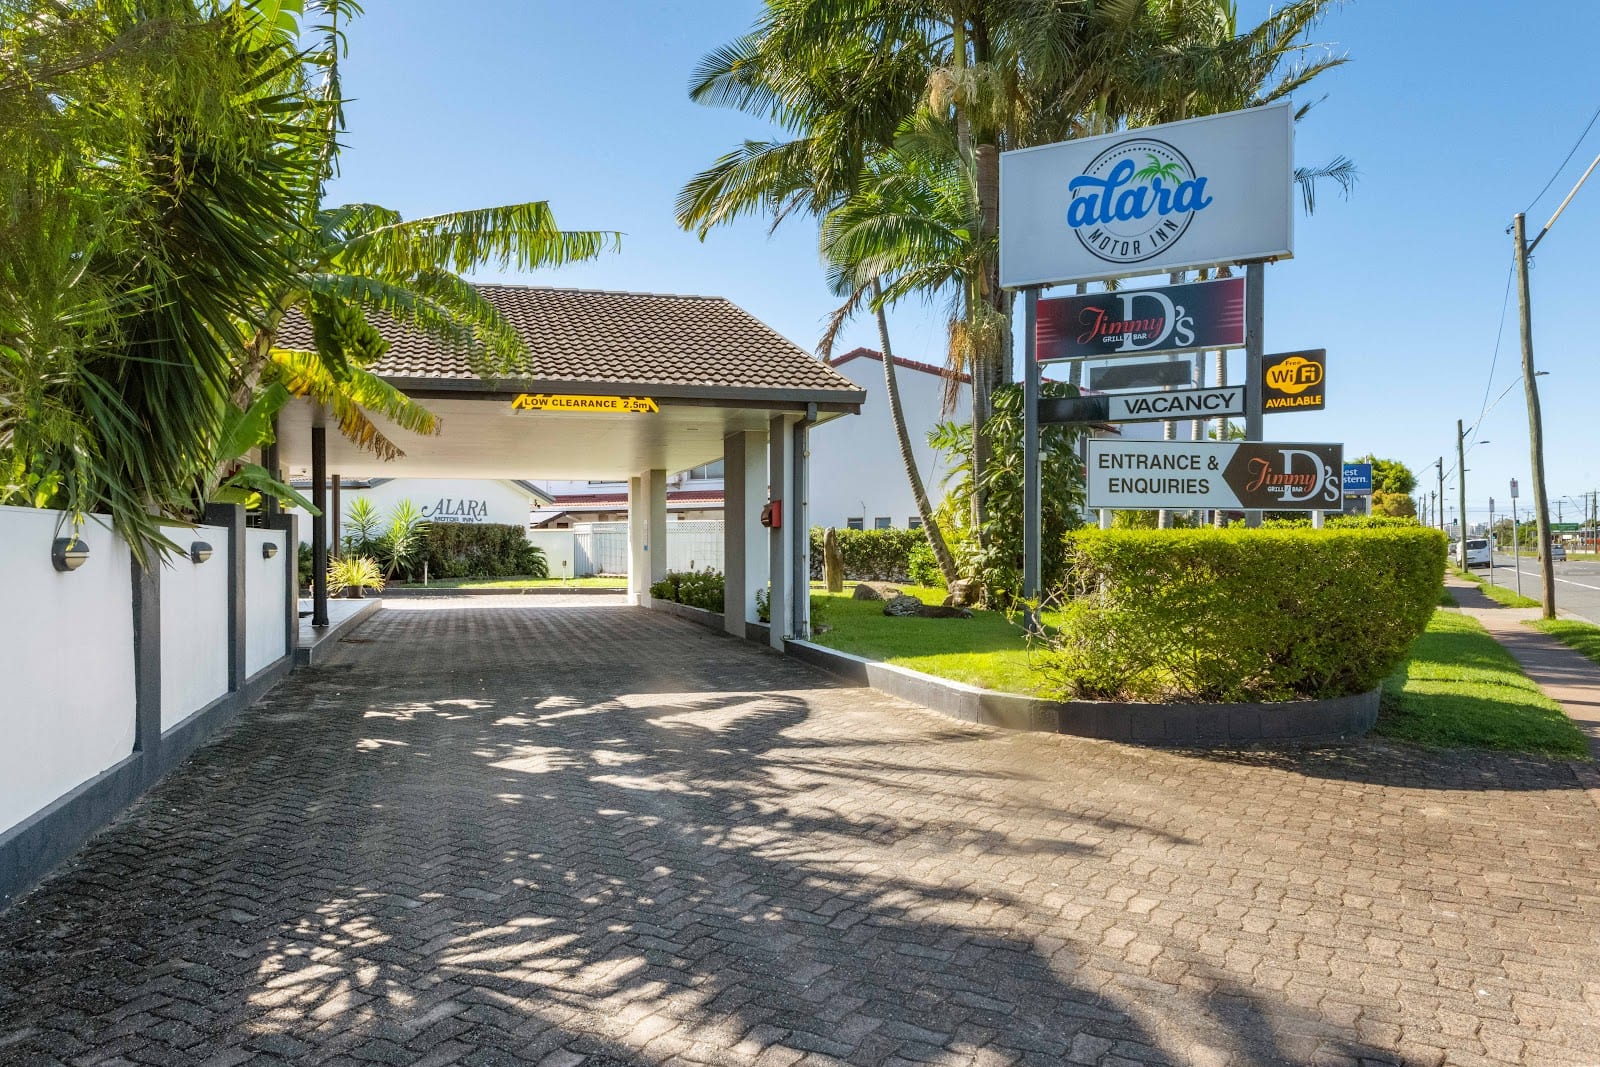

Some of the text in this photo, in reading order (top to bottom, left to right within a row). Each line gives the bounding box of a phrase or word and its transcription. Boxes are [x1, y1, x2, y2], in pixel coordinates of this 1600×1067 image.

[1067, 159, 1213, 229] alara
[1088, 219, 1178, 256] MOTOR INN
[1077, 291, 1195, 352] Jimmy D's
[524, 398, 648, 409] LOW CLEARANCE 2.5m
[1124, 392, 1236, 414] VACANCY
[1265, 395, 1322, 408] AVAILABLE
[1098, 453, 1220, 471] ENTRANCE &
[1108, 478, 1210, 495] ENQUIRIES
[1246, 449, 1340, 502] Jimmy D's
[421, 498, 488, 521] ALARA
